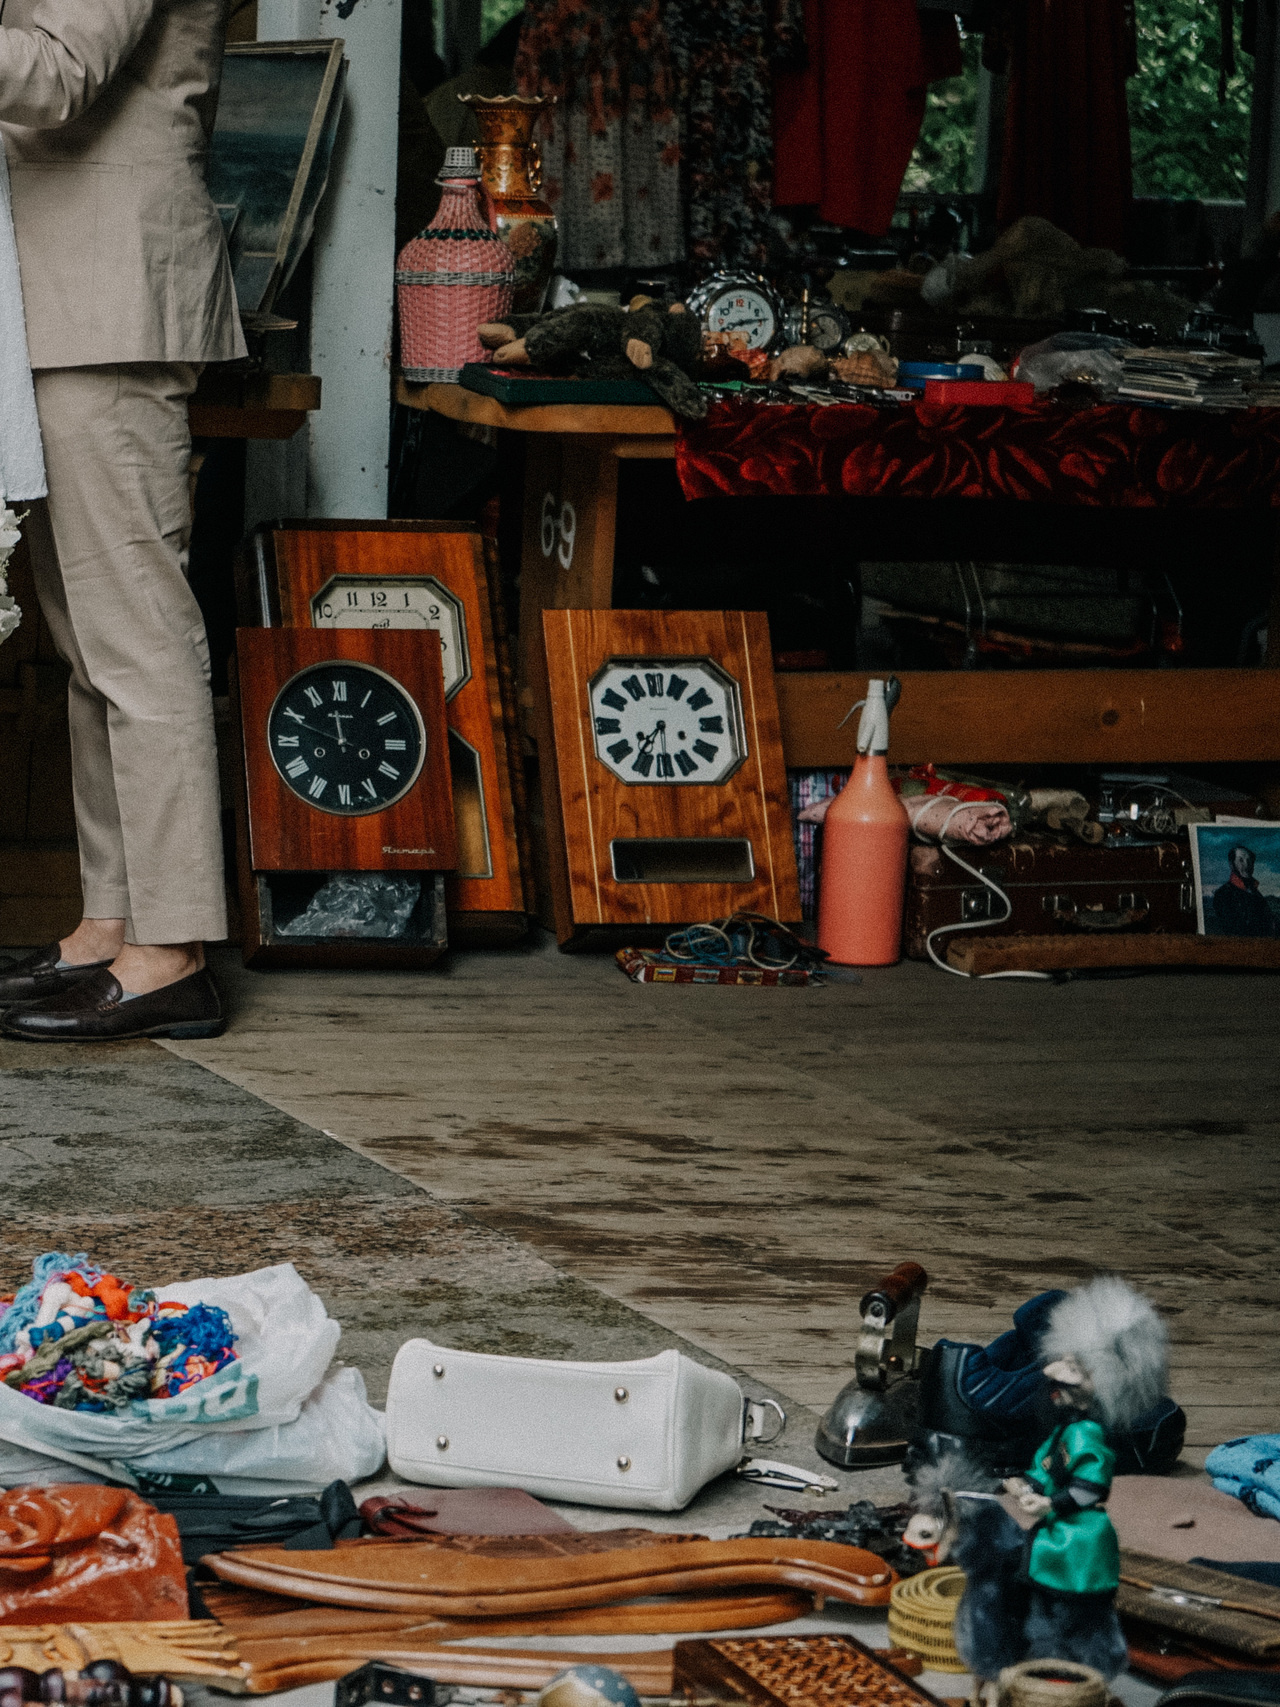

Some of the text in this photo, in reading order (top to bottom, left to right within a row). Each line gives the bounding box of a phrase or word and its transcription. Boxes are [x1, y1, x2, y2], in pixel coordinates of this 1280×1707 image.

[541, 491, 577, 570] 69
[346, 591, 359, 607] 11
[370, 591, 388, 608] 12
[403, 592, 411, 608] 1
[318, 603, 333, 620] 10
[428, 604, 441, 621] 2
[303, 685, 324, 709] XI
[332, 680, 348, 702] XII
[282, 706, 306, 725] X
[277, 734, 300, 748] IX
[384, 738, 407, 751] III
[307, 774, 328, 800] VII
[337, 784, 351, 806] VI
[360, 777, 378, 799] V
